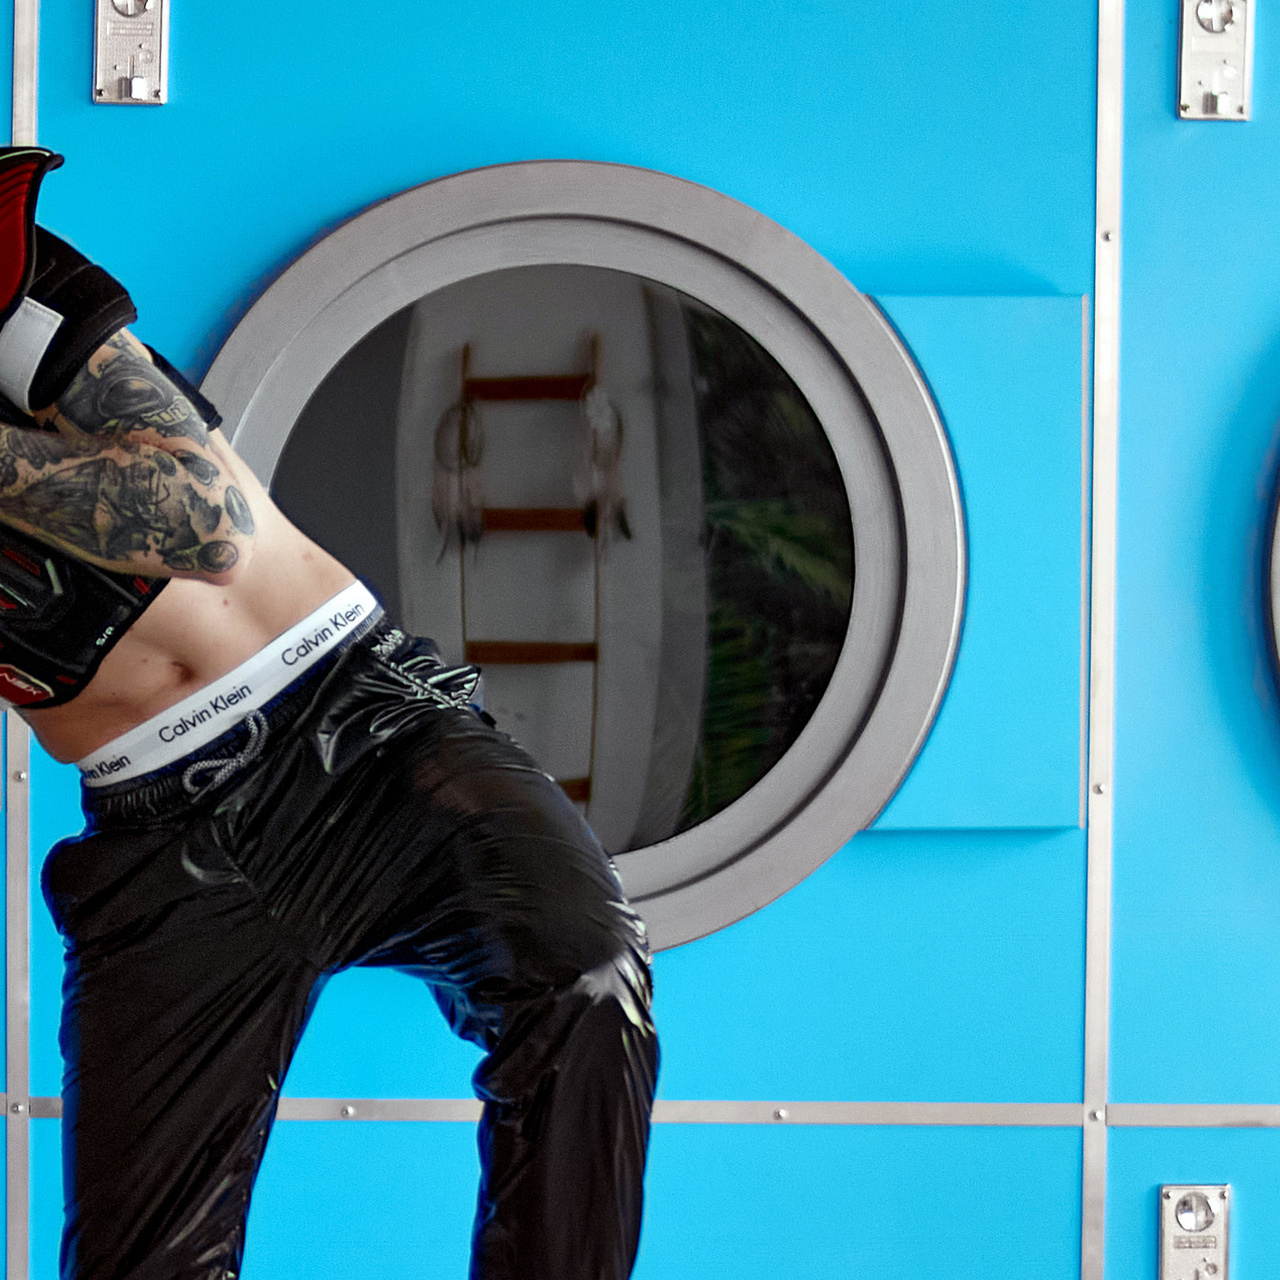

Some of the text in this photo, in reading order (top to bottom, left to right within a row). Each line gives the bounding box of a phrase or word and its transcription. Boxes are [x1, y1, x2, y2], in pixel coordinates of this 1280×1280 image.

[281, 603, 366, 666] Calvin Klein
[158, 685, 252, 743] Calvin Klein
[95, 755, 132, 777] Klein
